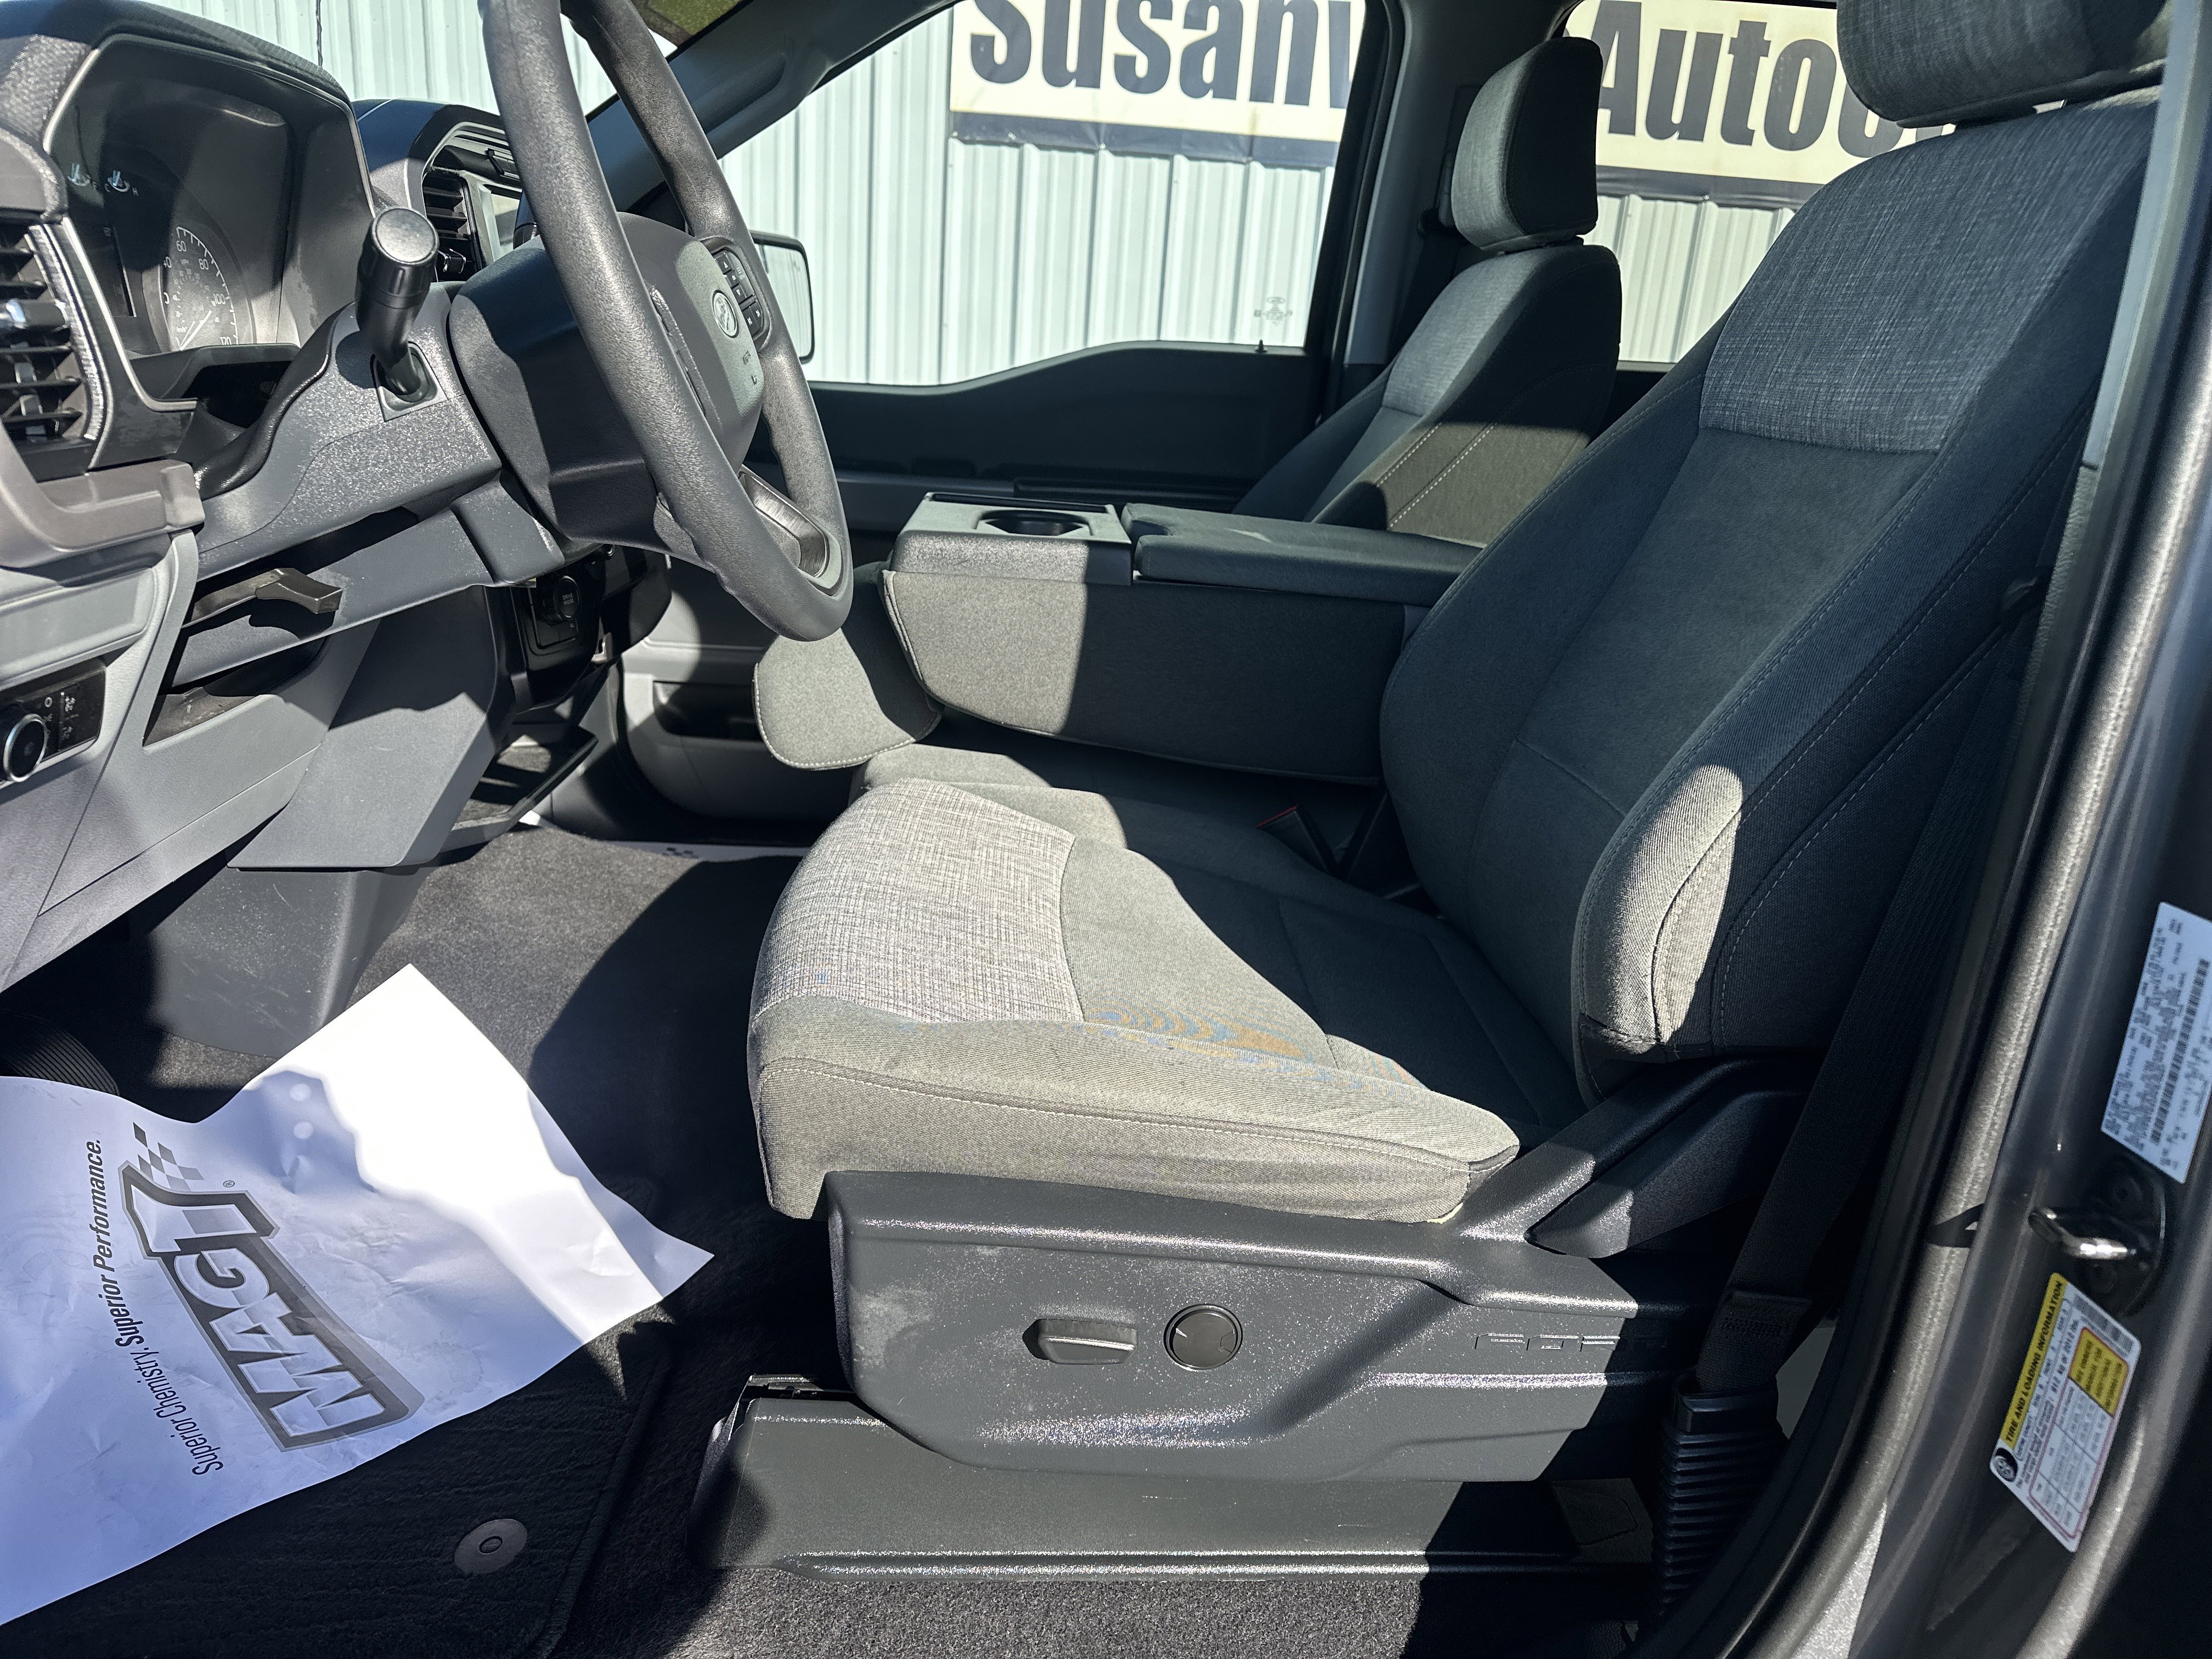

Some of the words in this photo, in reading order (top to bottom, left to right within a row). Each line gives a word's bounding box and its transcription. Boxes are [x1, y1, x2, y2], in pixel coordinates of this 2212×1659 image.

[1591, 0, 1943, 158] Auto
[176, 240, 187, 252] 60
[199, 258, 209, 270] 80
[213, 293, 225, 304] 100
[86, 1139, 115, 1272] Performance.
[98, 1273, 144, 1347] Superior
[130, 1347, 187, 1418] Chemistry.
[2006, 1419, 2019, 1442] TIRE
[2015, 1397, 2025, 1420] AND
[2022, 1352, 2041, 1397] LOADING
[2036, 1281, 2063, 1351] INFORMATION
[171, 1418, 224, 1475] Superior
